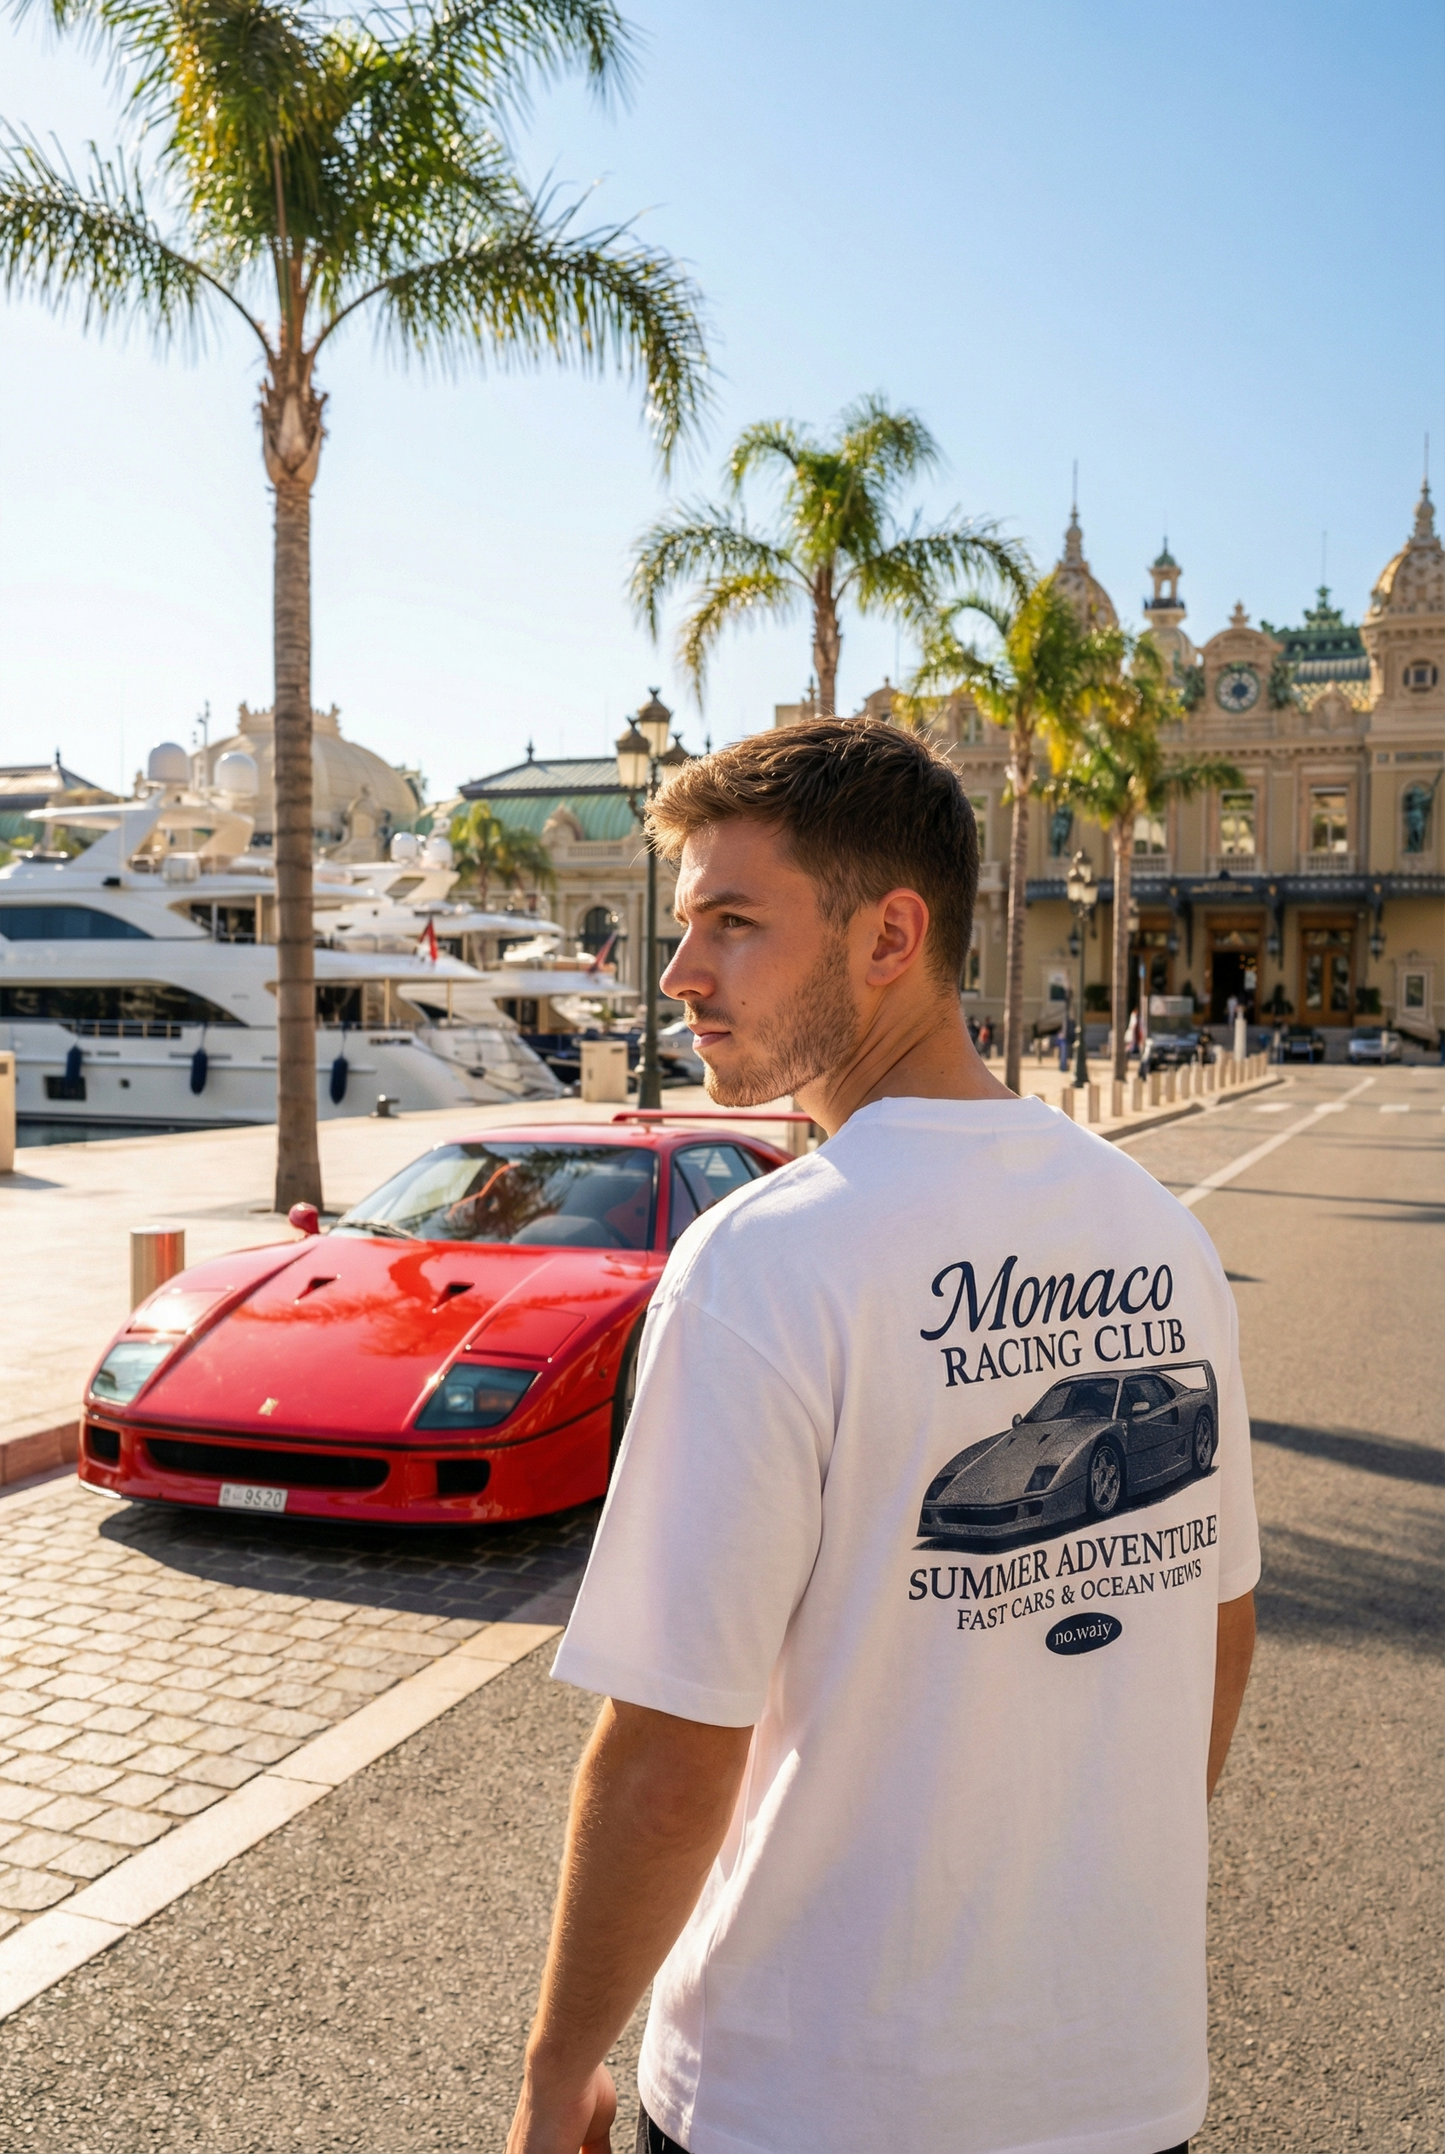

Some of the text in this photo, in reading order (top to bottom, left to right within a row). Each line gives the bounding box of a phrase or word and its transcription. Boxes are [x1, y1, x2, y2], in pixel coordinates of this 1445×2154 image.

[920, 1255, 1173, 1341] Monaco
[940, 1319, 1186, 1388] RACING CLUB
[244, 1488, 283, 1508] 9520
[908, 1515, 1218, 1601] SUMMER ADVENTURE
[957, 1558, 1202, 1631] FAST CARS & OCEAN VIEWS
[1054, 1619, 1113, 1646] no.waiy
